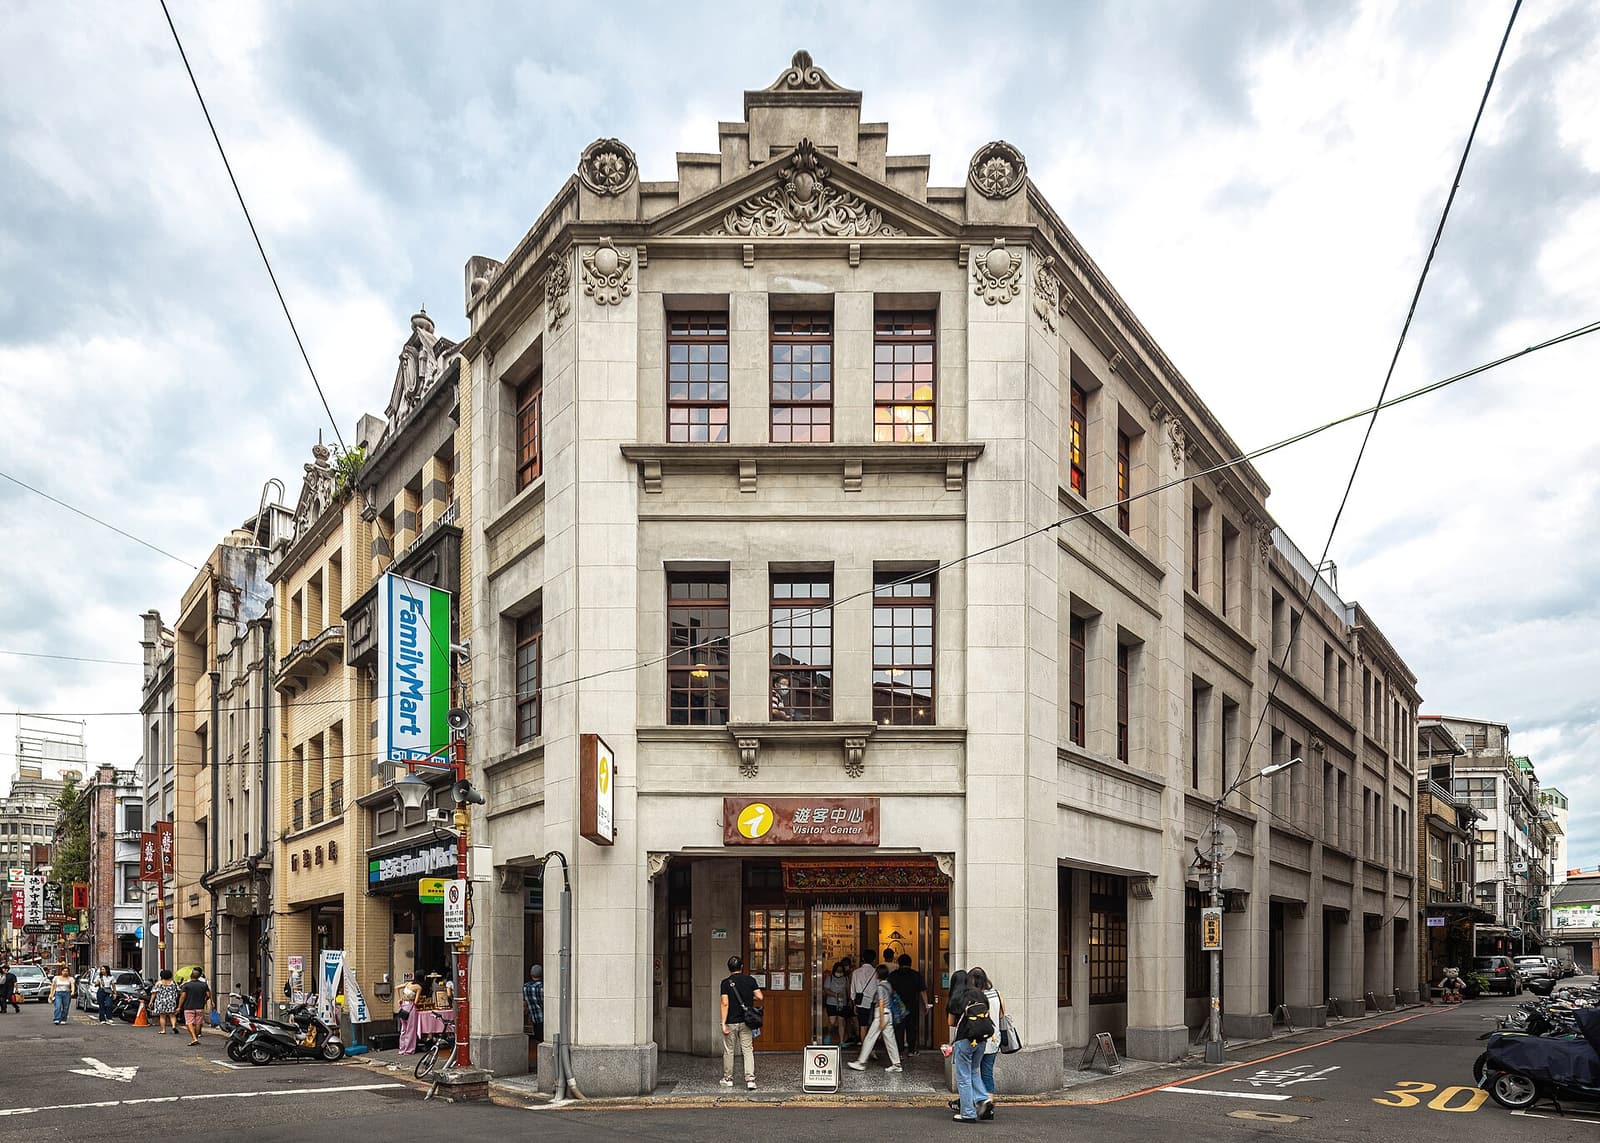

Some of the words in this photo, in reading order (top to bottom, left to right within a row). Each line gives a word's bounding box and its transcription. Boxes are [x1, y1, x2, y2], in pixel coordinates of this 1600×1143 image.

[396, 593, 424, 736] FamilyMart
[792, 807, 864, 824] 遊客中心
[792, 825, 824, 834] Visitor
[829, 825, 863, 834] Center
[1372, 1081, 1490, 1112] 30
